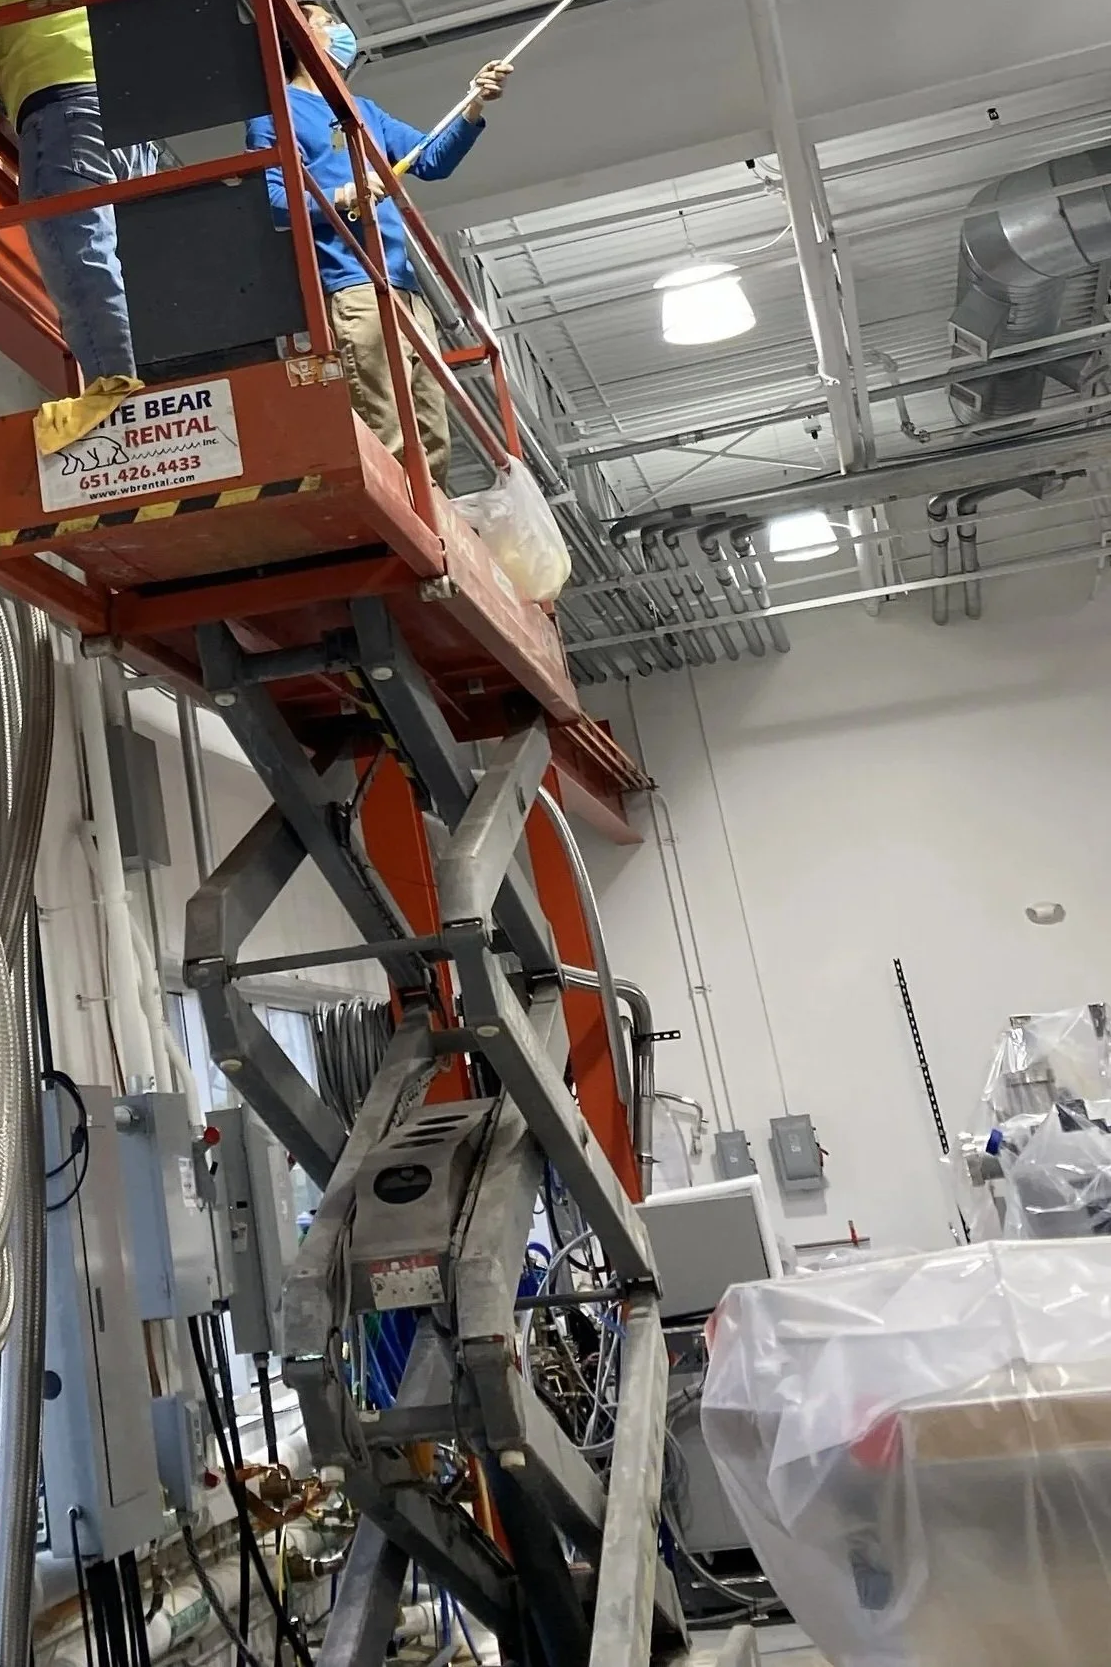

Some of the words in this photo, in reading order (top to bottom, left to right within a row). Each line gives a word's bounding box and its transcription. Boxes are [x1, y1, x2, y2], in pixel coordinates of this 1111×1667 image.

[145, 389, 212, 419] BEAR
[124, 415, 216, 448] RENTAL
[202, 438, 219, 447] Inc.
[80, 455, 201, 490] 651.426.4433
[89, 474, 195, 500] www.wbrental.com
